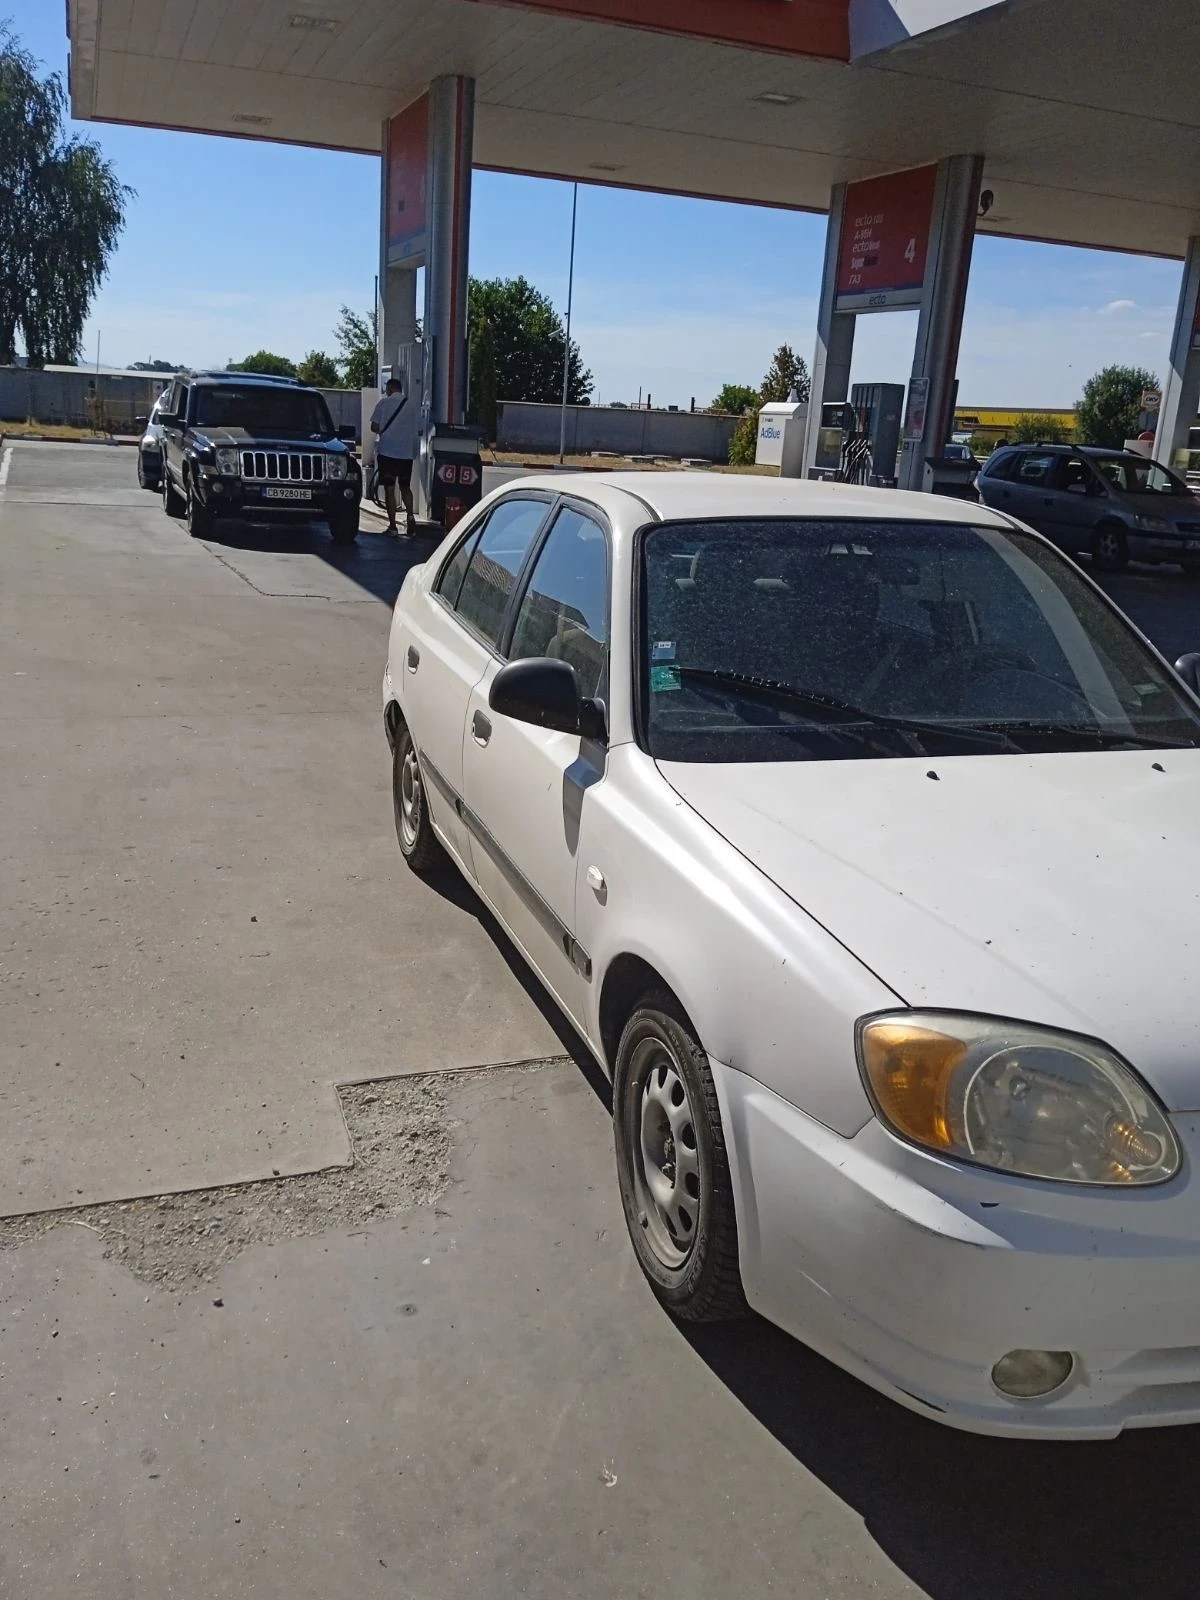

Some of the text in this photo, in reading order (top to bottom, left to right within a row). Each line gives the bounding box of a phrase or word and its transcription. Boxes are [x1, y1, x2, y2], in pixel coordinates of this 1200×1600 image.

[904, 238, 916, 264] 4
[868, 294, 886, 305] ecto
[760, 427, 780, 439] AdBlue
[445, 468, 453, 479] 6
[462, 470, 470, 481] 5
[279, 489, 299, 498] 9280
